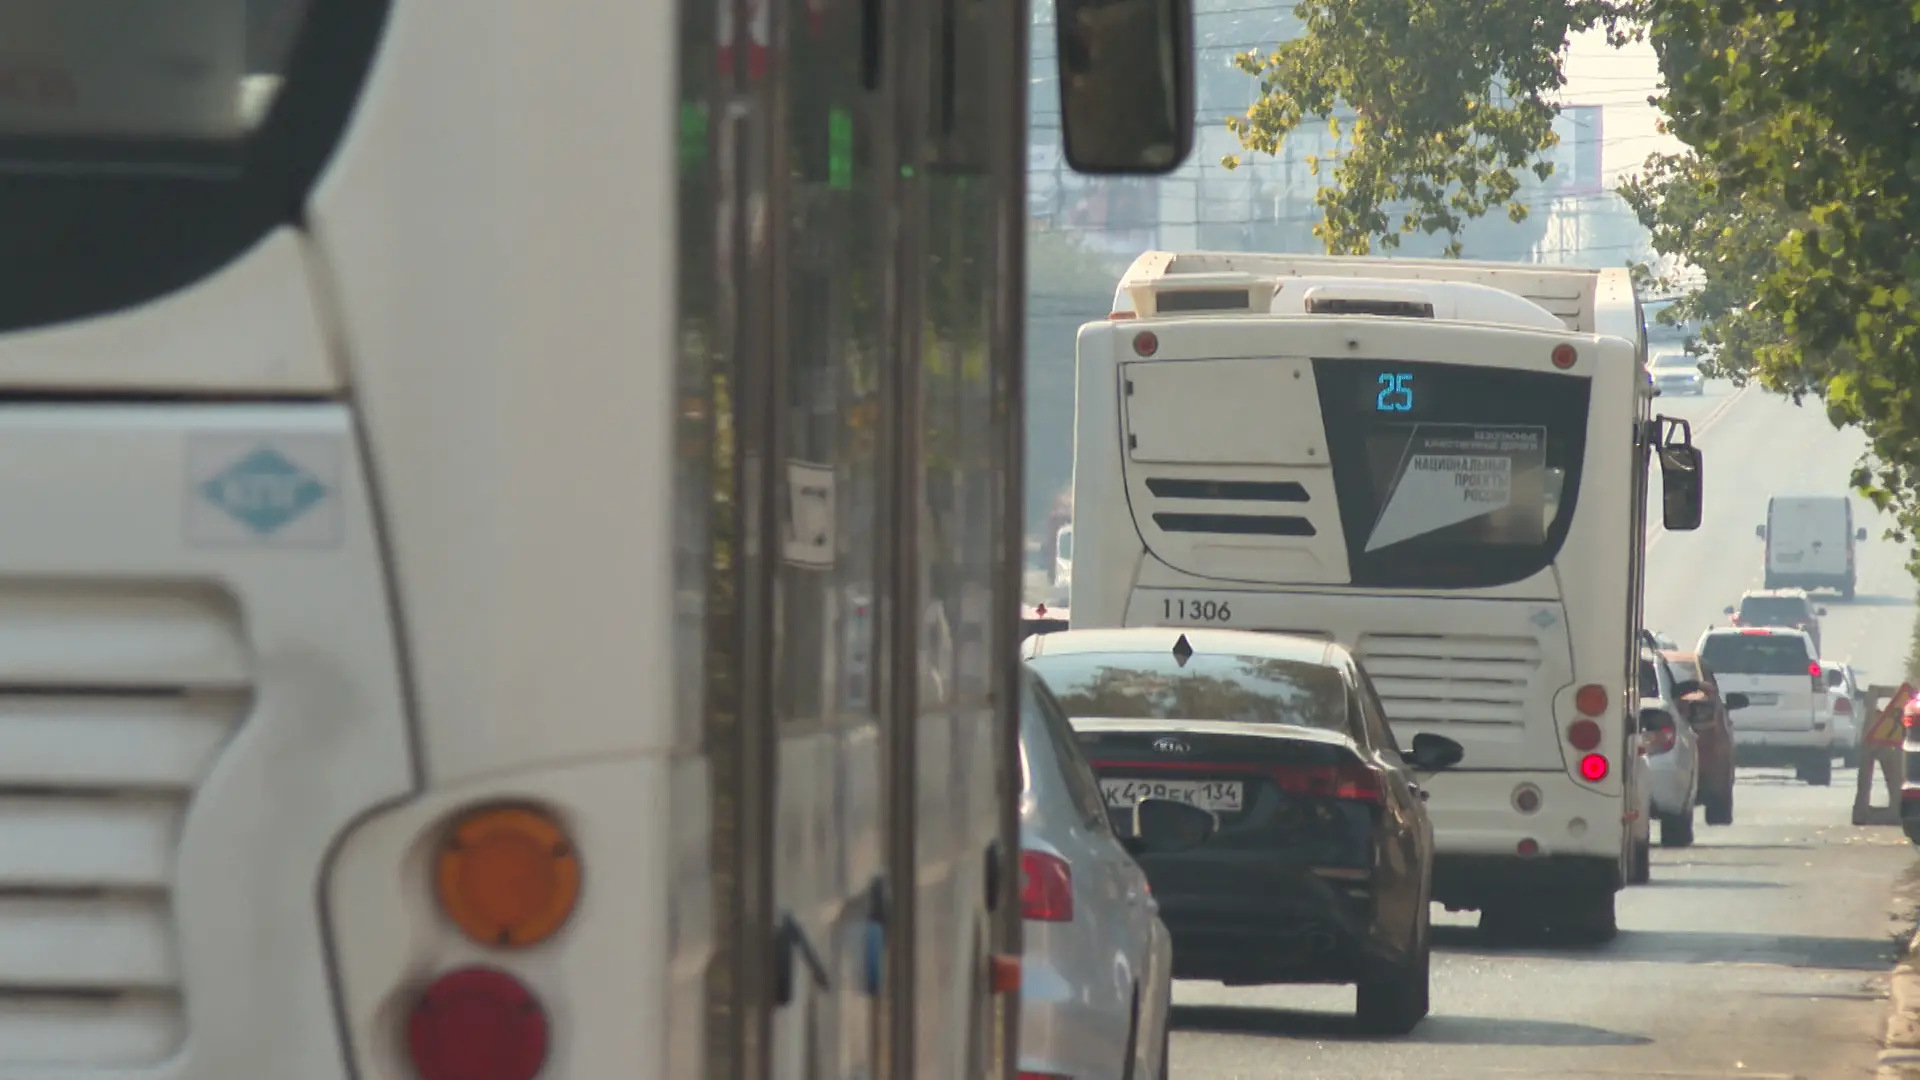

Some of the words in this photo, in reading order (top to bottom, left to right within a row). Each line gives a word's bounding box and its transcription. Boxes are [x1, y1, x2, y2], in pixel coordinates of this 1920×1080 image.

[1376, 373, 1413, 411] 25
[1163, 598, 1232, 622] 11306
[1203, 783, 1237, 801] 134
